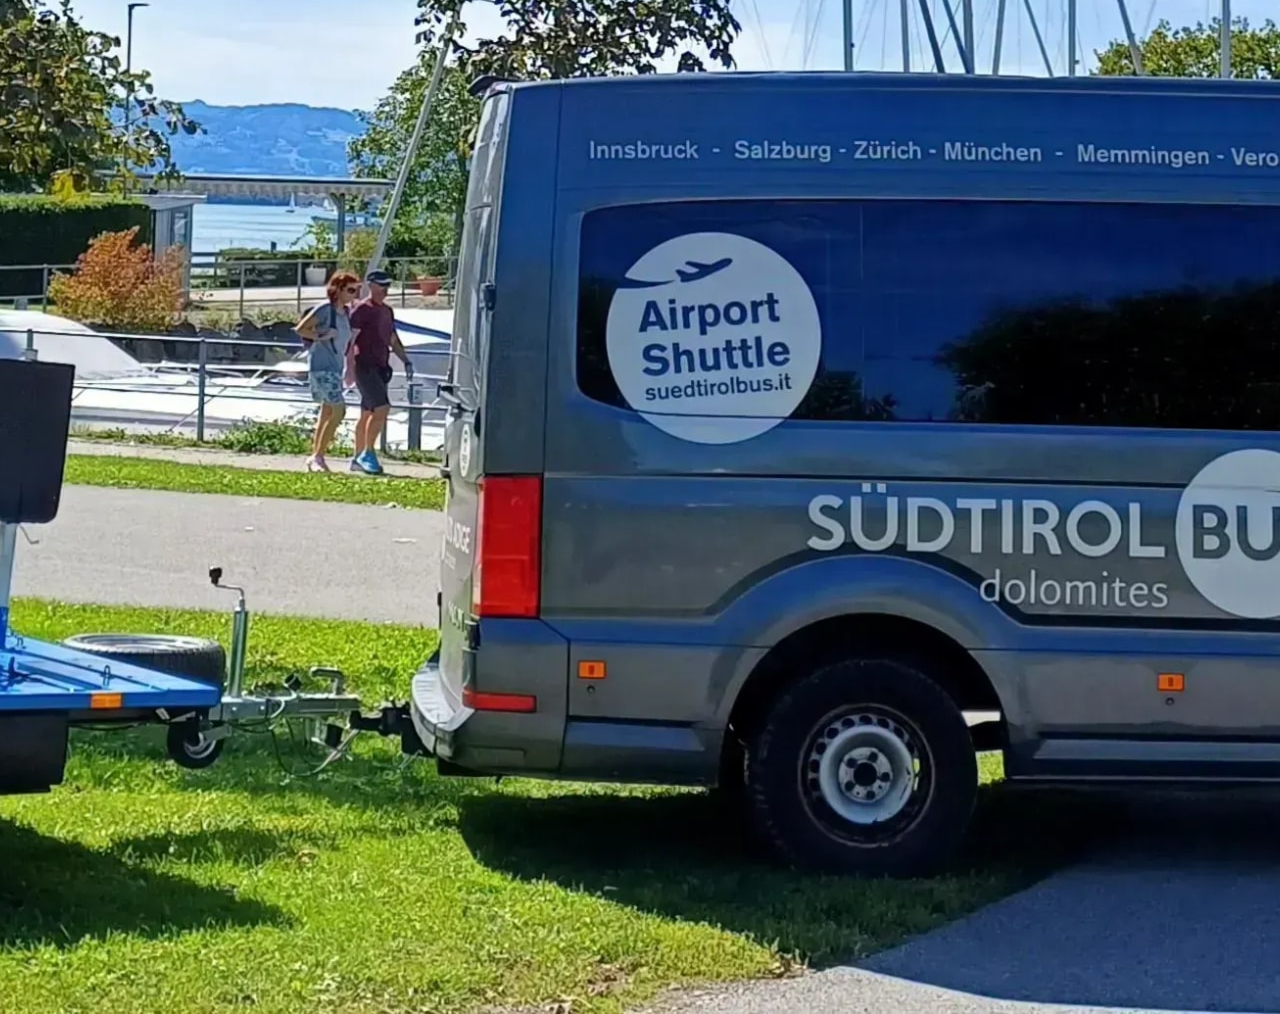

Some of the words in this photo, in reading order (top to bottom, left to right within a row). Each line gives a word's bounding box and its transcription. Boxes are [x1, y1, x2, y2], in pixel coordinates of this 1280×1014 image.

[590, 140, 699, 159] Innsbruck
[733, 140, 832, 163] Salzburg
[853, 139, 922, 160] Zürich
[944, 140, 1042, 162] München
[1077, 144, 1210, 168] Memmingen
[638, 292, 780, 336] Airport
[642, 336, 791, 376] Shuttle
[645, 373, 793, 401] suedtirolbus.it
[807, 482, 1166, 558] SÜDTIROL
[980, 569, 1168, 608] dolomites
